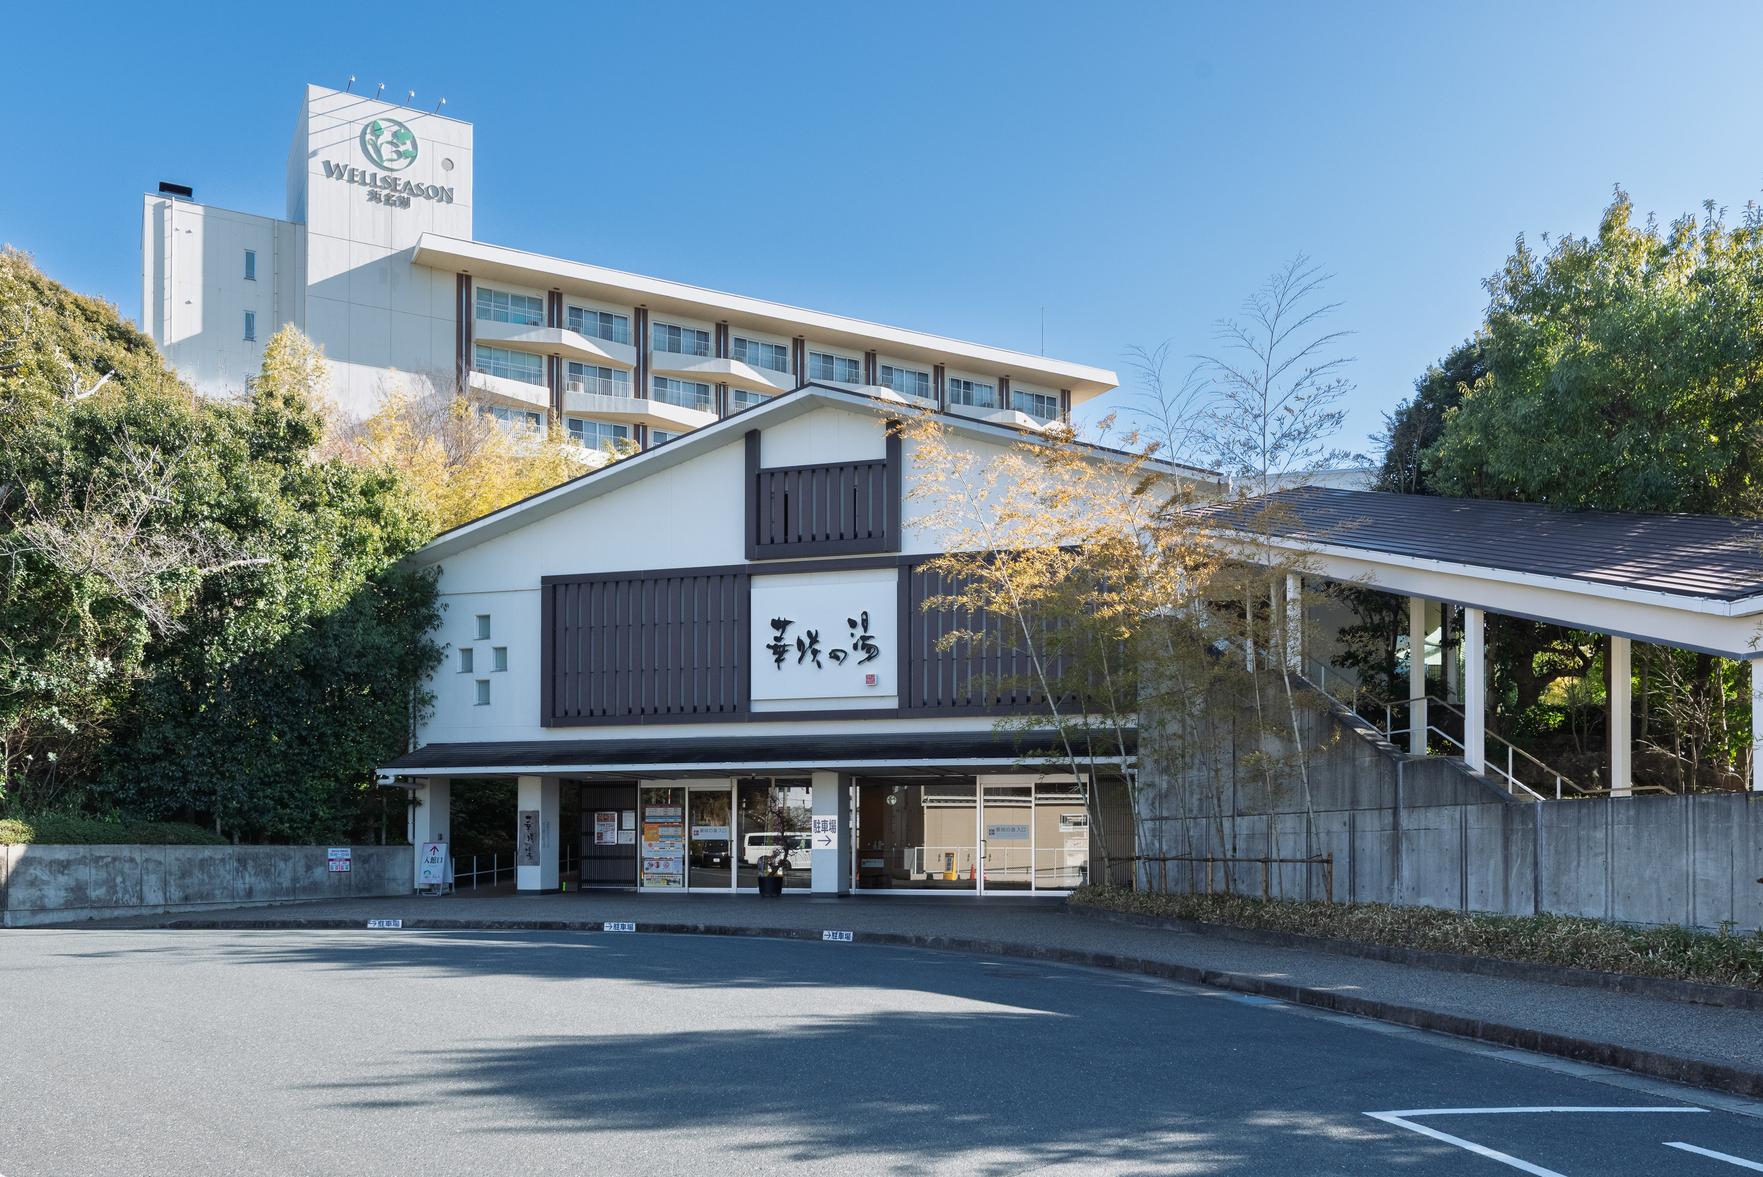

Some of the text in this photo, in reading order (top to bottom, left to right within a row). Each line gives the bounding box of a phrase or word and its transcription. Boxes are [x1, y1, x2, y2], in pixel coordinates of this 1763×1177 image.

[322, 160, 454, 204] WELLSEASON
[766, 611, 879, 671] 華咲の湯
[813, 819, 836, 833] 駐車場
[378, 920, 400, 928] 駐車場
[613, 923, 634, 931] 駐車場
[831, 931, 851, 940] 駐車場
